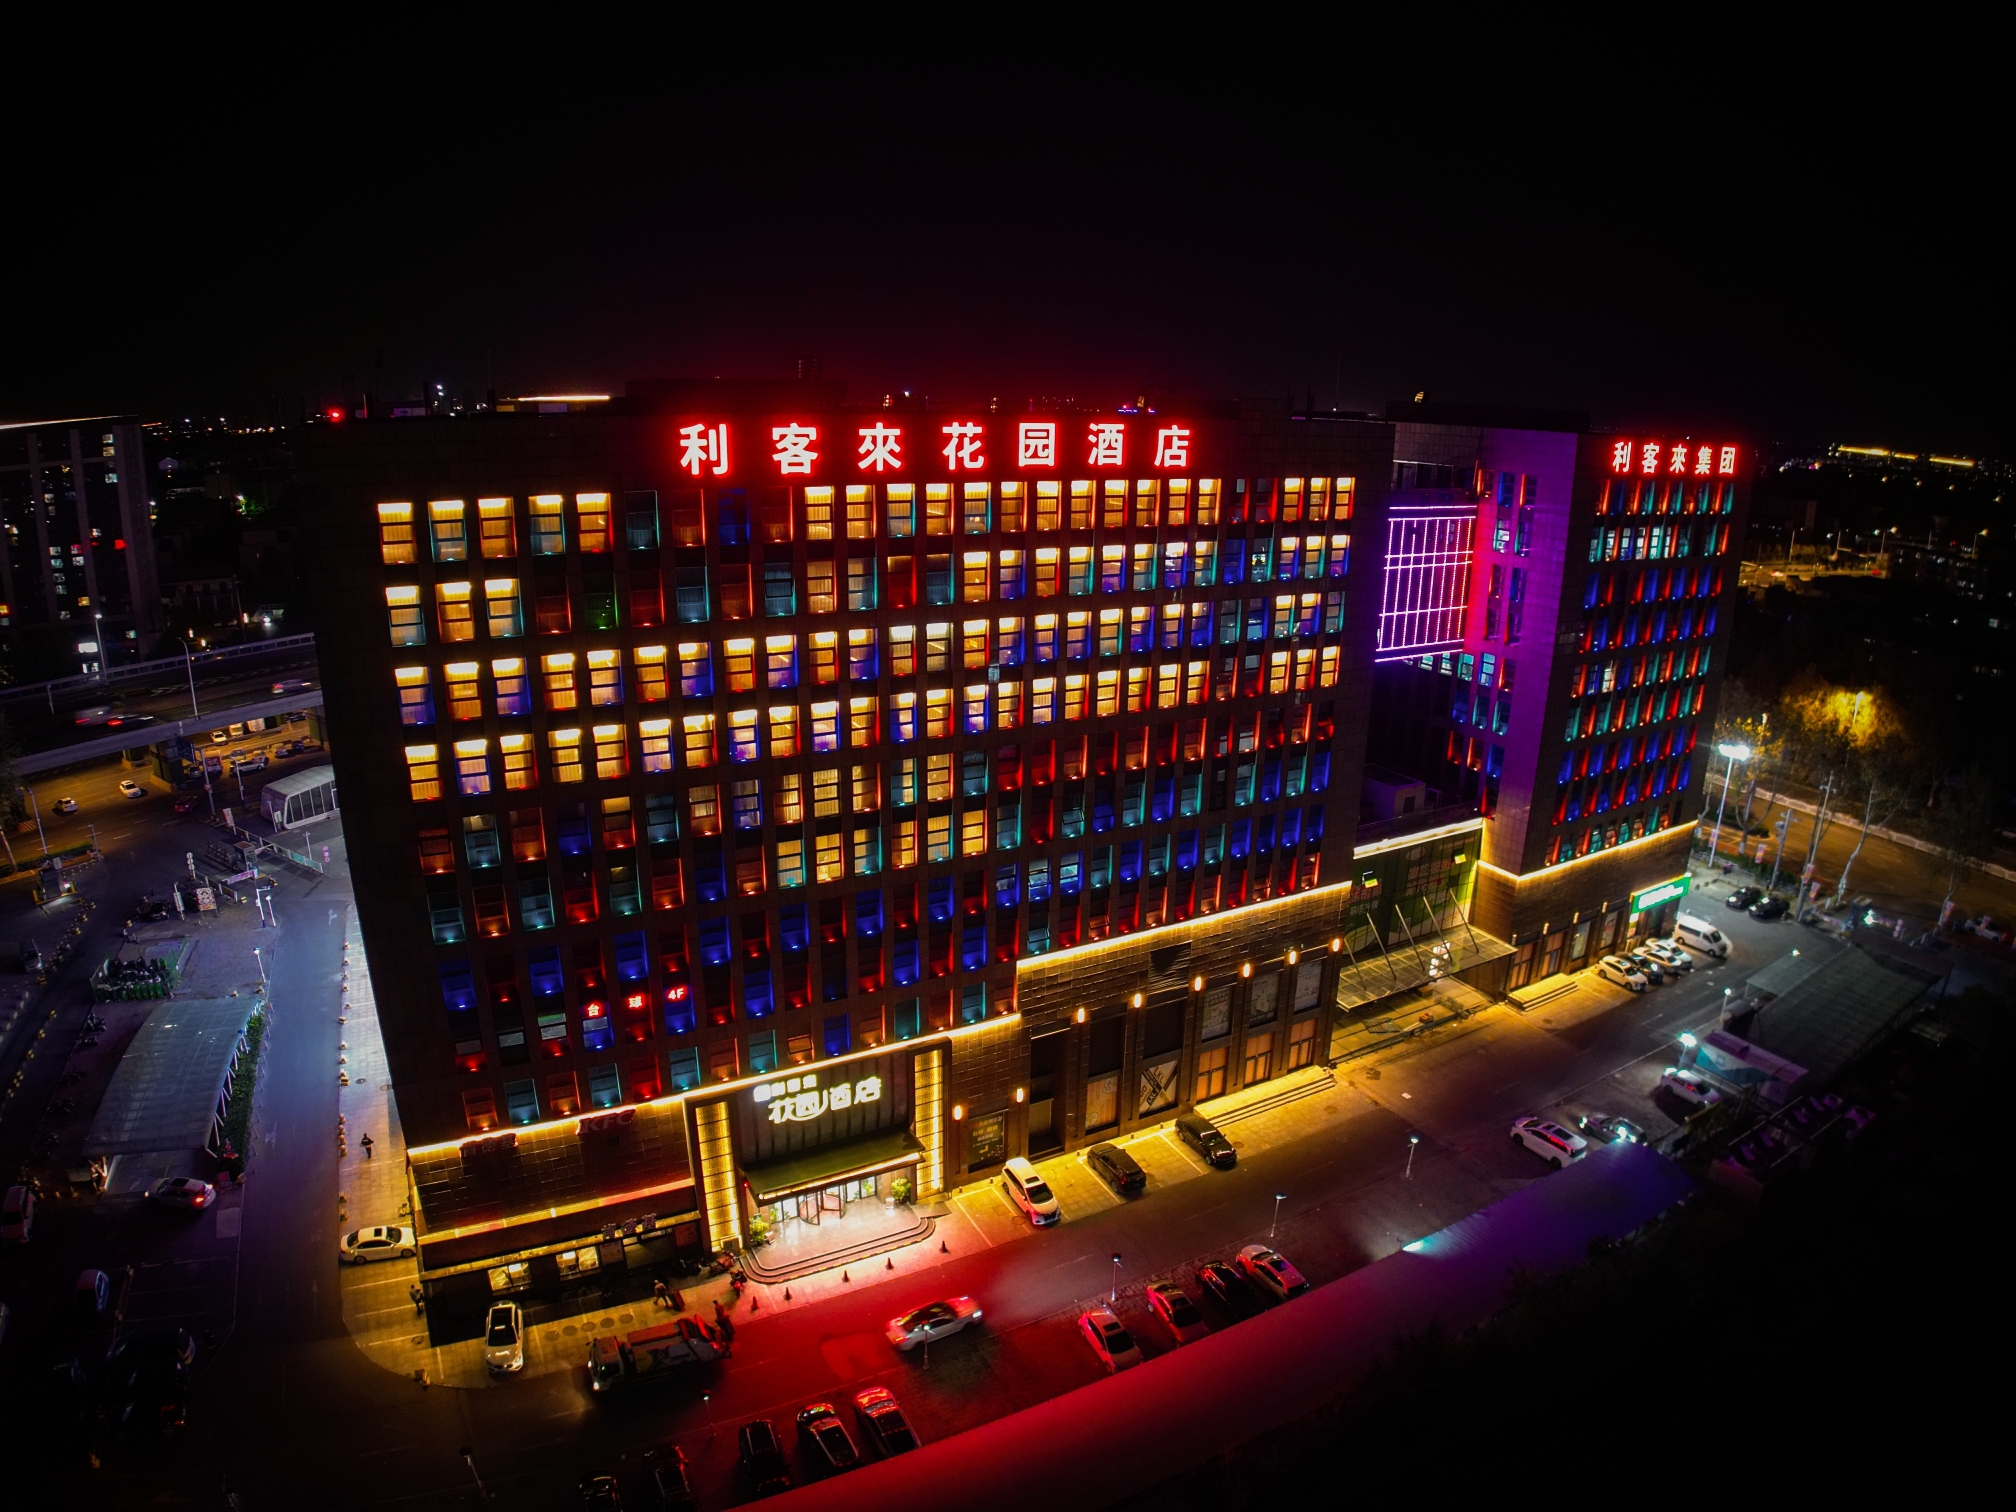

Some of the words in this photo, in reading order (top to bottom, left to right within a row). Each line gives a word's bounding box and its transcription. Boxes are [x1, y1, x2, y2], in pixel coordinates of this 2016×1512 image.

[679, 422, 1191, 475] 利客來花园酒店
[1613, 441, 1736, 475] 利客來集团
[582, 1112, 632, 1134] KFC
